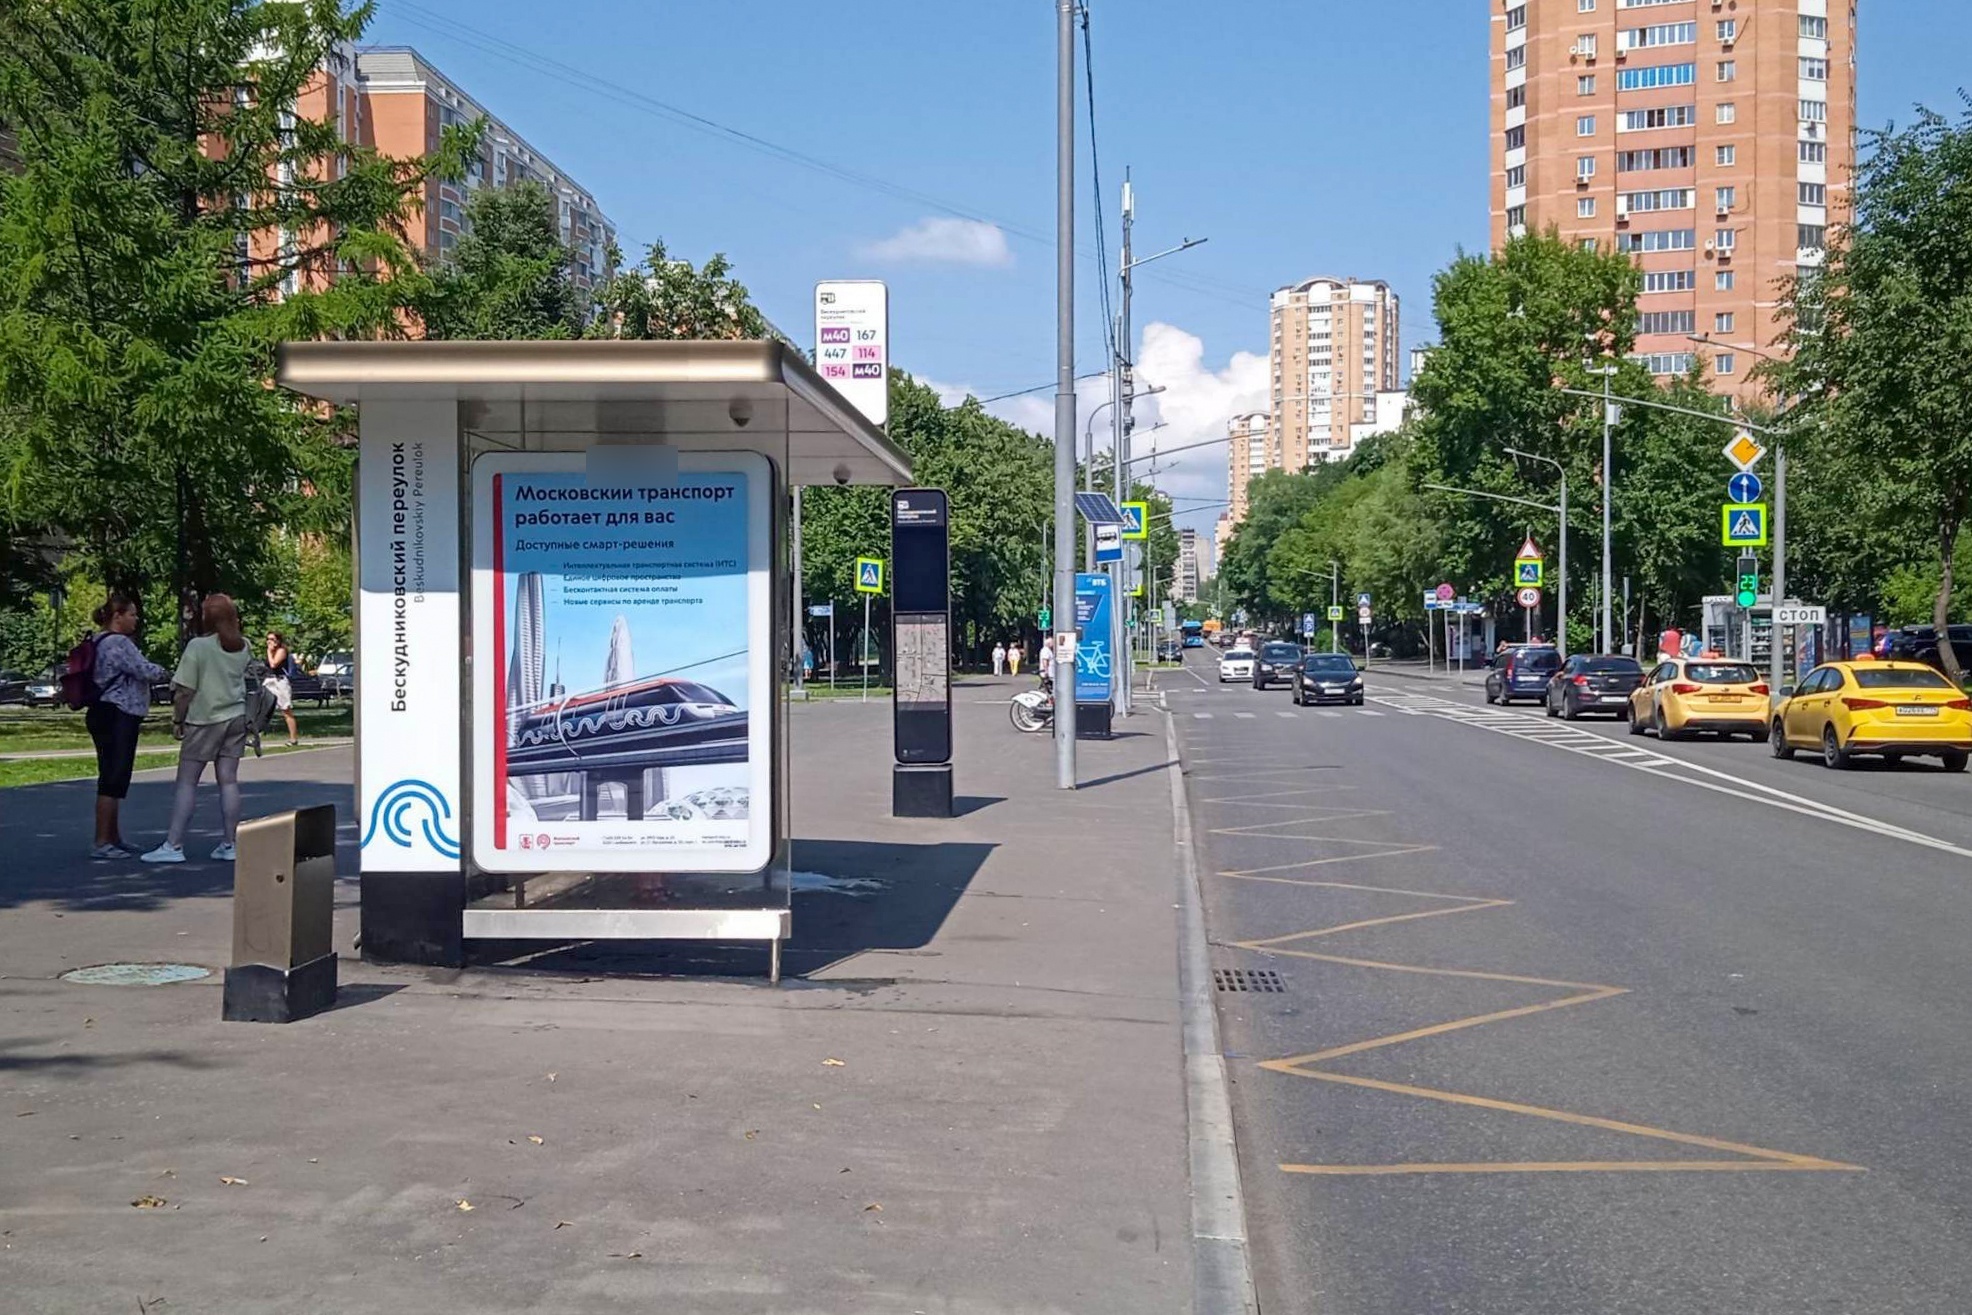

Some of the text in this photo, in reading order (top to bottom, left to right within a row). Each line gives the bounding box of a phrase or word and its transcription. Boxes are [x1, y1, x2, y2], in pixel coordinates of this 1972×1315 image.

[822, 330, 876, 341] м40 167
[824, 348, 875, 358] 447 114
[826, 365, 880, 377] 154 м40
[637, 486, 734, 502] транспорт
[413, 442, 427, 603] Beskudnikovskiy Pereulok
[515, 510, 675, 528] работает для вас
[515, 540, 674, 551] Доступные смарт-решения
[390, 442, 410, 712] Бескудниковский переулок
[1740, 575, 1755, 589] 23
[1522, 593, 1535, 601] 40
[1779, 610, 1818, 621] СТОП
